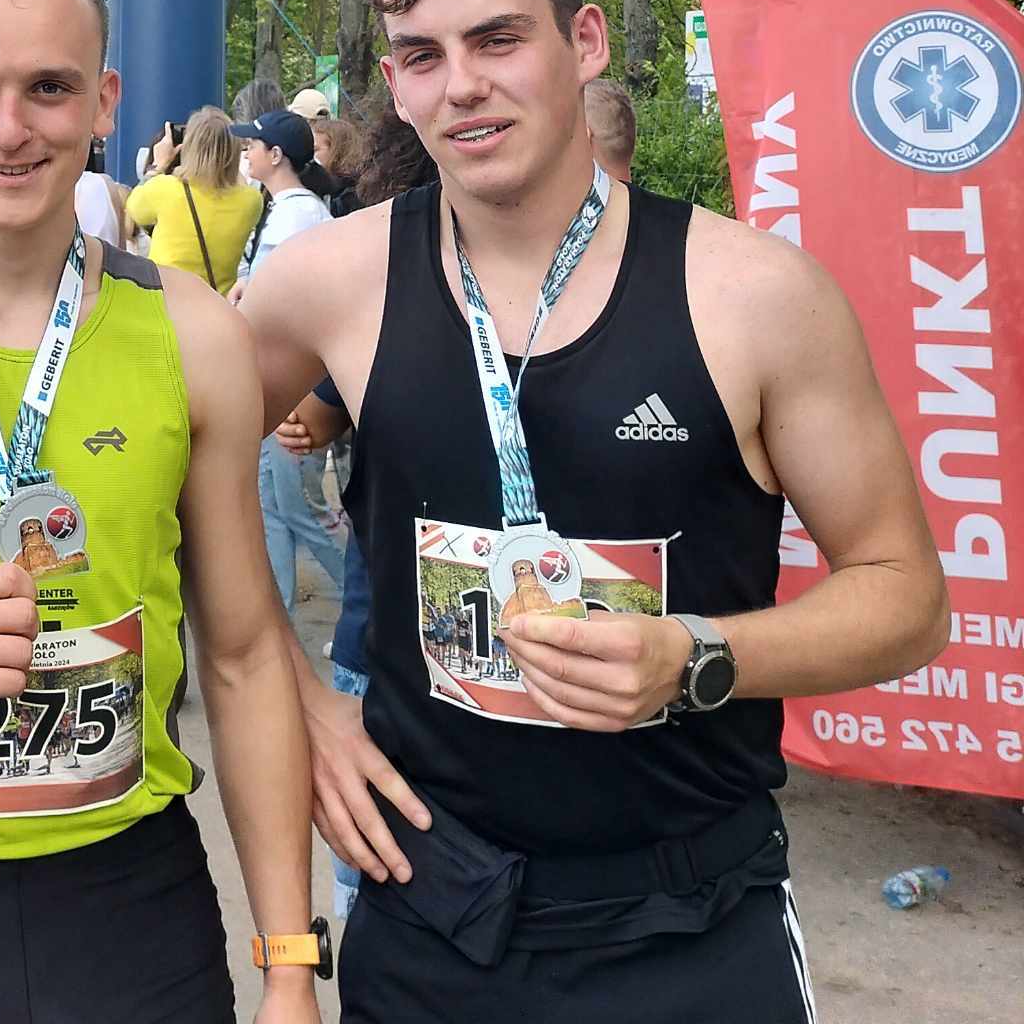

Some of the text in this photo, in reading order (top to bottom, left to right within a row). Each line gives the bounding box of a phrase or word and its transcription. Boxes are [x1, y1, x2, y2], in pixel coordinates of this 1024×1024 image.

[476, 326, 497, 375] GEBERIT
[41, 338, 66, 391] GEBERIT
[614, 423, 690, 442] adidas
[38, 588, 74, 598] ENTER
[32, 639, 77, 651] ARATON
[32, 651, 56, 659] OŁO
